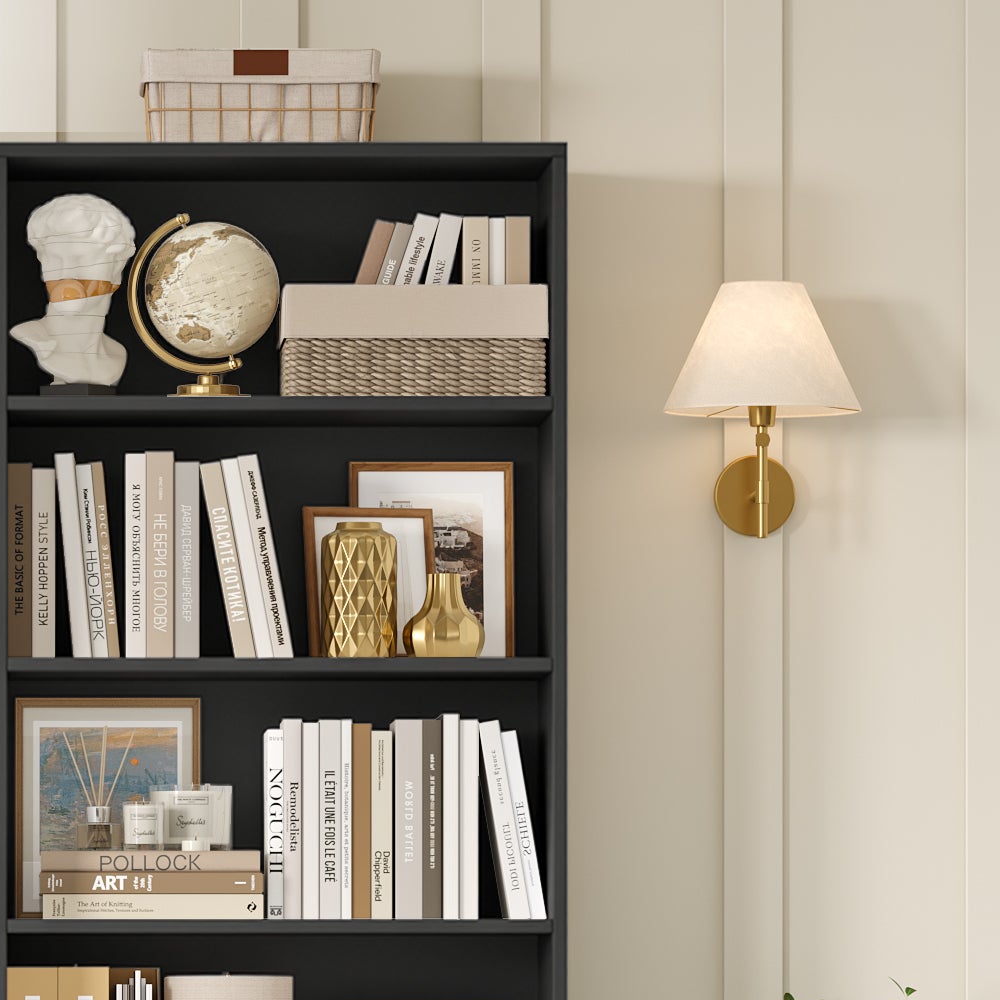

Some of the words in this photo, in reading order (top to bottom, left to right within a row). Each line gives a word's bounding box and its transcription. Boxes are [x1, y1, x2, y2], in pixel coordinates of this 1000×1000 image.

[410, 236, 425, 265] lifestyle
[472, 239, 481, 253] ON
[382, 259, 396, 285] GUIDE
[97, 504, 108, 539] РОСС
[132, 493, 140, 521] МОГУ
[153, 513, 168, 530] НЕ
[180, 504, 192, 537] ДАВИД
[15, 504, 24, 546] FORMAT
[38, 512, 48, 544] STYLE
[212, 507, 235, 564] СПАСИТЕ
[15, 549, 24, 562] OF
[132, 525, 140, 587] ОБЪЯСНИТЬ
[153, 534, 168, 566] БЕРИ
[15, 565, 24, 594] BASIC
[38, 547, 48, 590] HOPPEN
[153, 570, 168, 578] В
[181, 538, 192, 623] СЕРВАН-ШРЕЙБЕР
[85, 550, 105, 641] НЬЮ-ЙОРК
[223, 566, 246, 623] КОТИКА!
[257, 526, 268, 551] Метод
[272, 602, 285, 646] проектами
[15, 596, 24, 615] THE
[38, 594, 48, 626] KELLY
[132, 590, 140, 633] МНОГОЕ
[153, 581, 168, 632] ГОЛОВУ
[324, 770, 335, 778] IL
[324, 780, 337, 805] ÉTAIT
[269, 768, 283, 873] NOGUCHI
[289, 782, 300, 852] Remodelista
[324, 807, 335, 825] UNE
[324, 826, 335, 846] FOIS
[99, 854, 201, 872] POLLOCK
[324, 849, 335, 858] LE
[382, 851, 390, 874] David
[92, 875, 127, 891] ART
[324, 860, 337, 883] CAFÉ
[373, 851, 383, 902] Chipperfield
[108, 901, 133, 909] Knitting
